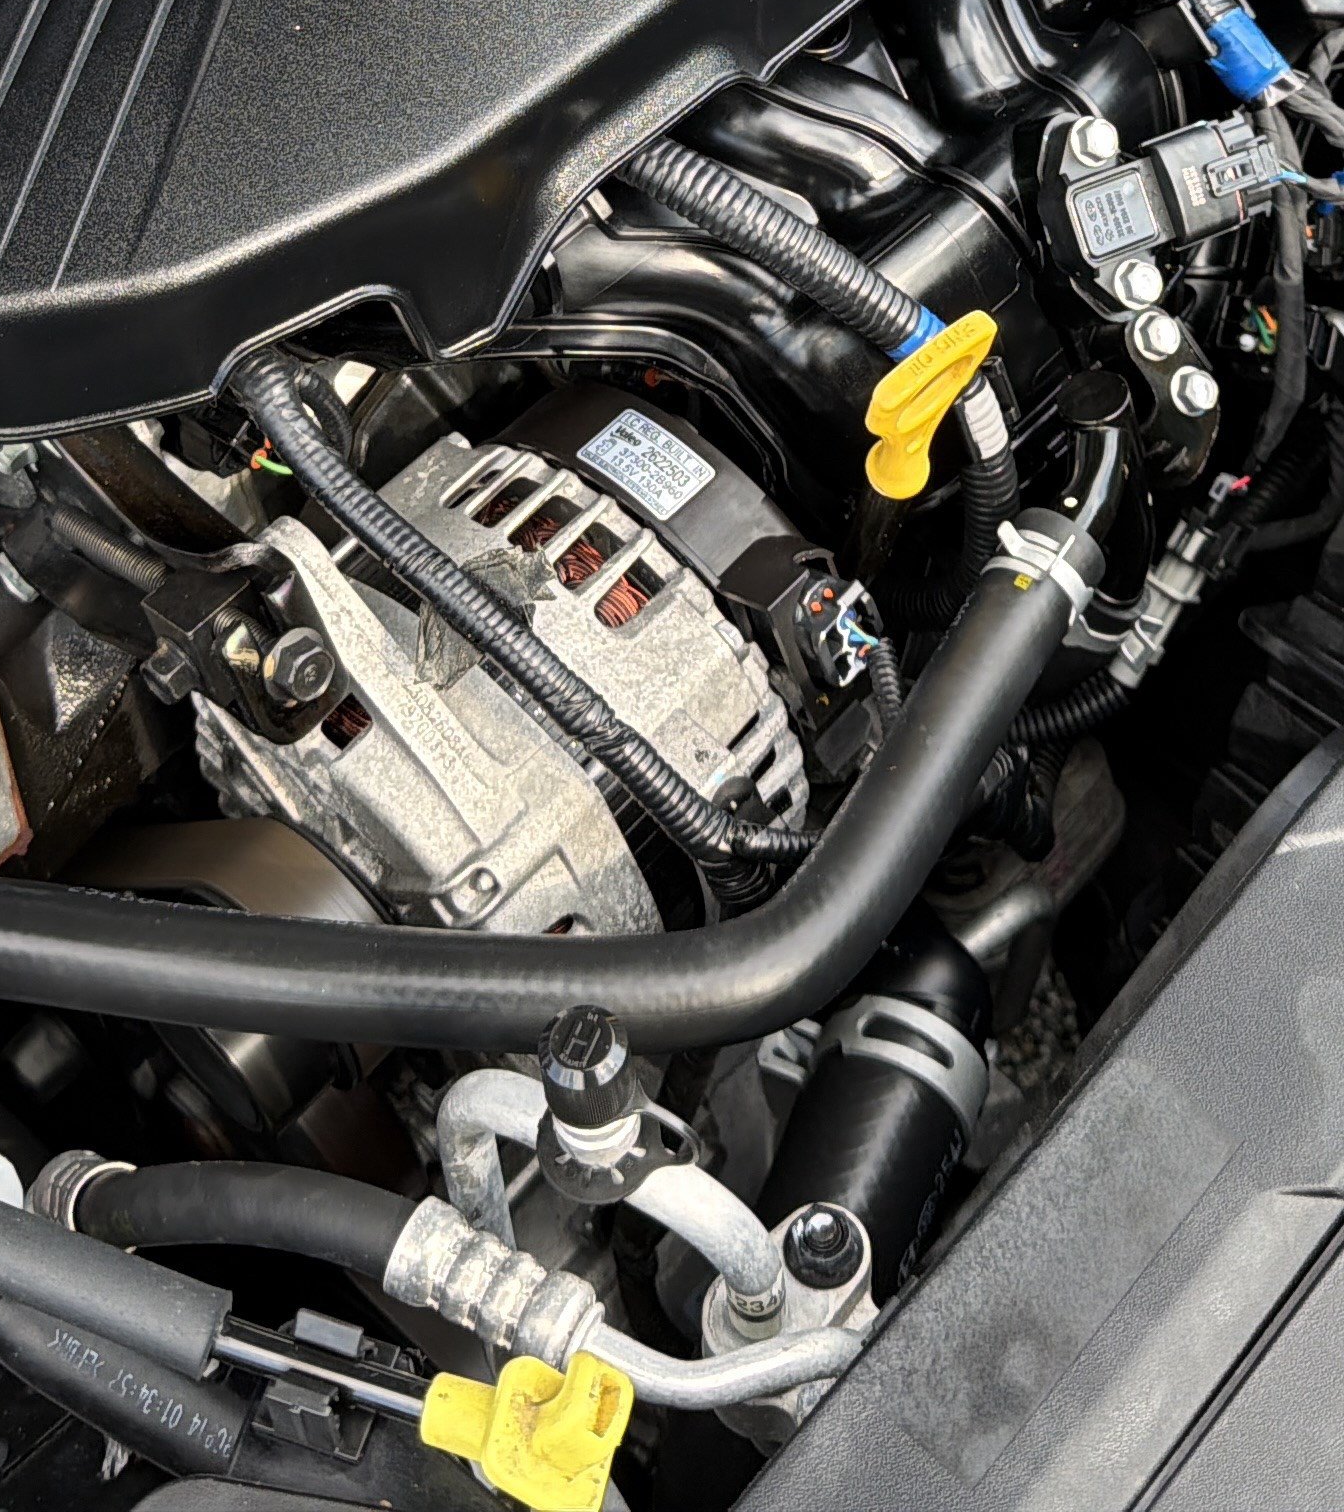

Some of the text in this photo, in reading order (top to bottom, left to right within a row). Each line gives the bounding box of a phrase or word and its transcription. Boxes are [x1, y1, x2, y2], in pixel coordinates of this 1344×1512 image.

[614, 425, 642, 447] Valeo
[641, 446, 692, 488] 2622503
[618, 447, 684, 499] 37300-2B960
[661, 436, 692, 463] BUILT
[610, 455, 664, 499] 13.5V 130A
